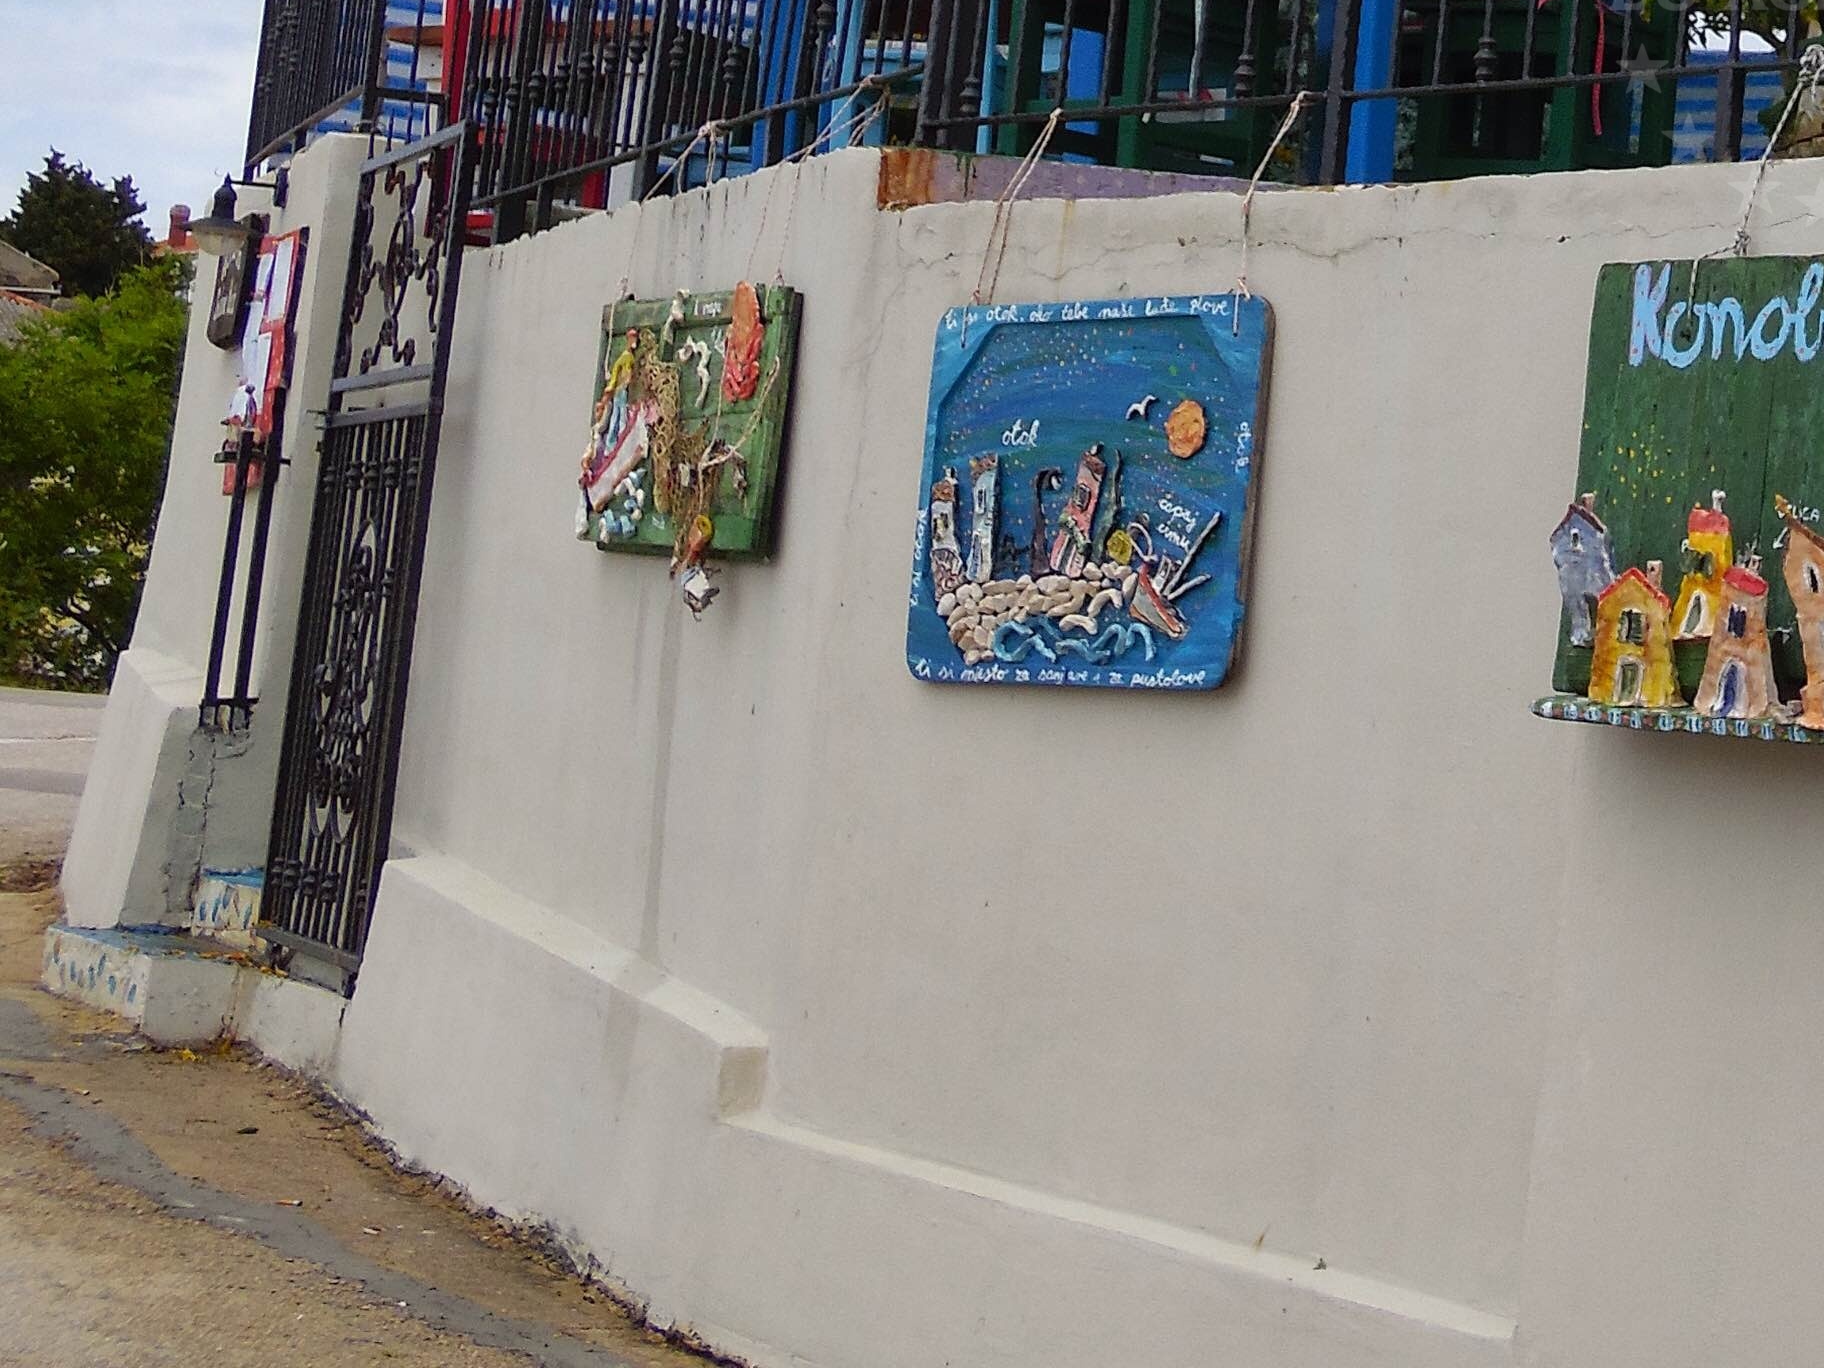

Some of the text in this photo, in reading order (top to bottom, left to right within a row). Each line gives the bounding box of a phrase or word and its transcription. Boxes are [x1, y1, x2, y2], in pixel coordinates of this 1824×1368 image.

[1189, 295, 1229, 316] plove
[1002, 418, 1040, 448] otok
[1130, 667, 1206, 688] pustolove
